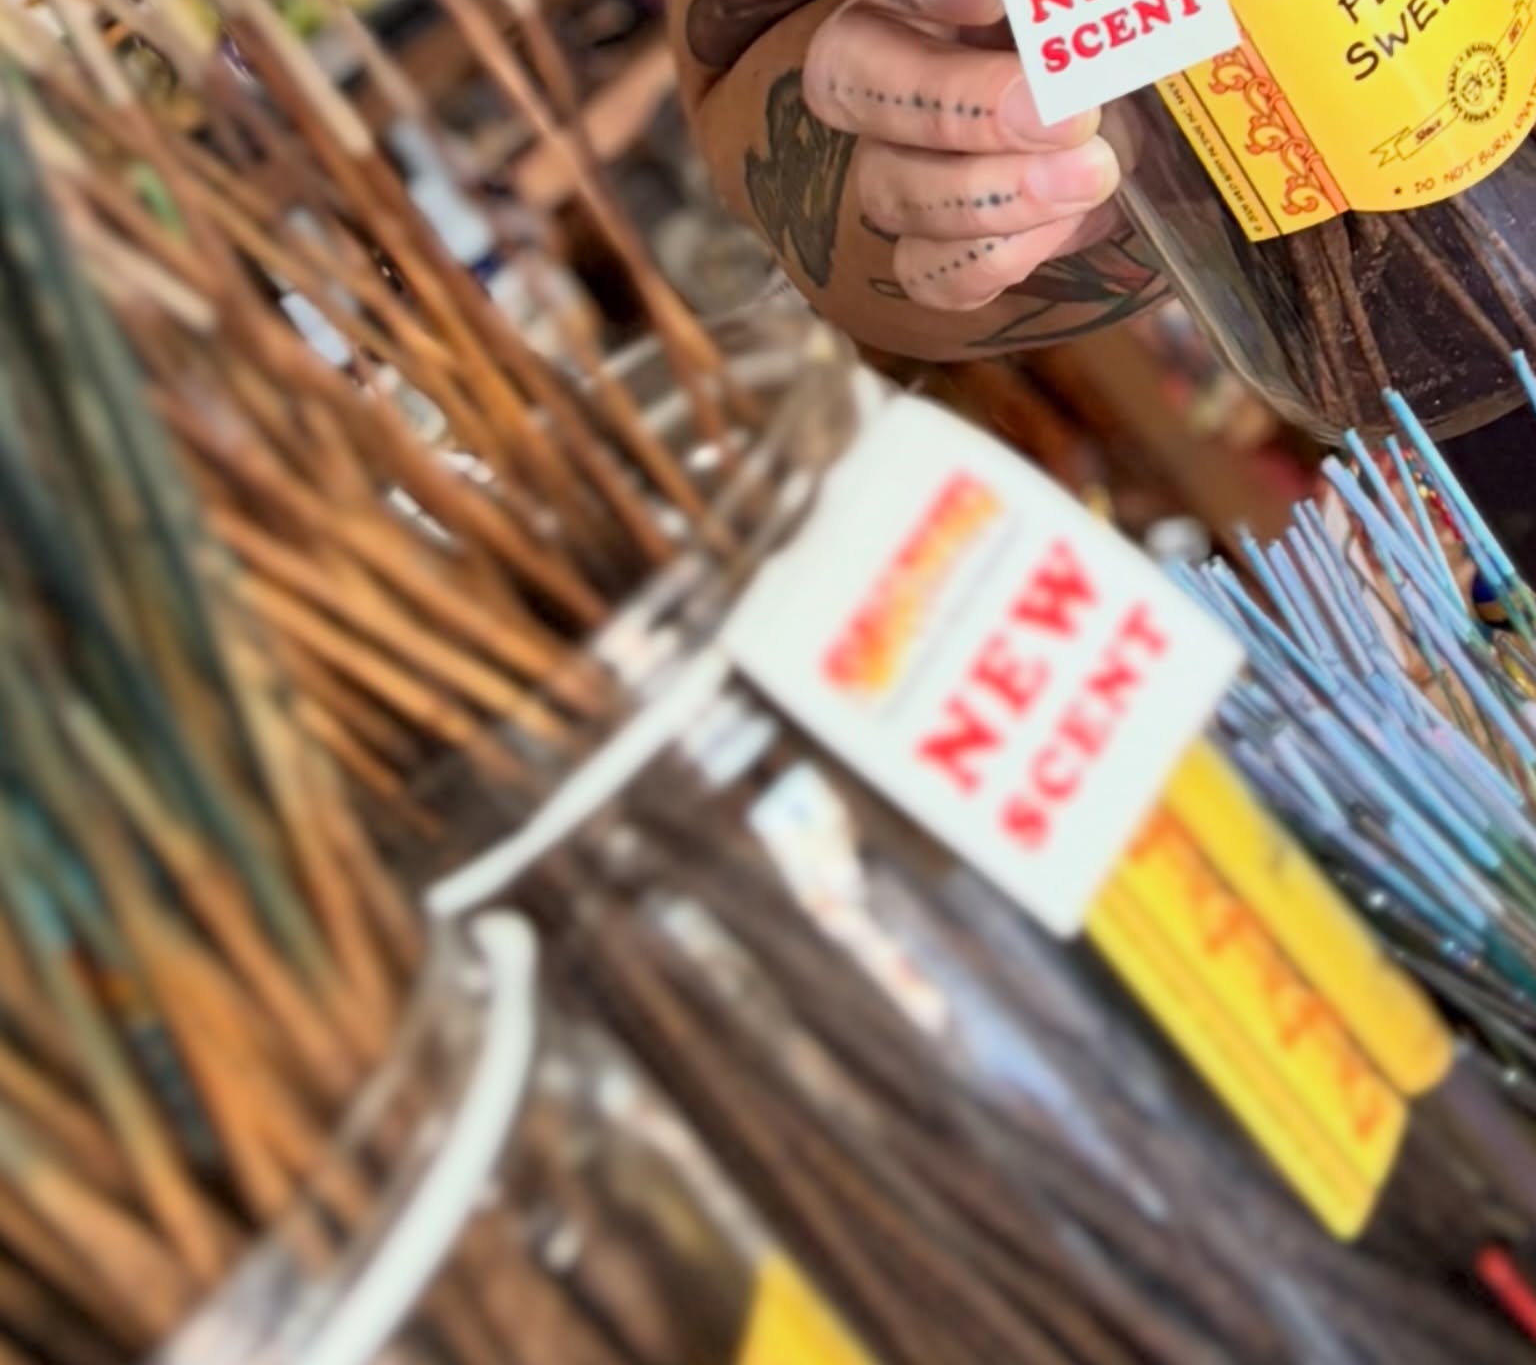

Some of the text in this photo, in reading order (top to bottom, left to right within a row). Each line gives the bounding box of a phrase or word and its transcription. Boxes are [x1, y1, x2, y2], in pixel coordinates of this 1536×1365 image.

[1414, 177, 1435, 193] DO
[1444, 157, 1474, 183] NOT
[1478, 132, 1512, 166] BURN
[914, 537, 1101, 796] NEW
[998, 600, 1170, 854] SCENT
